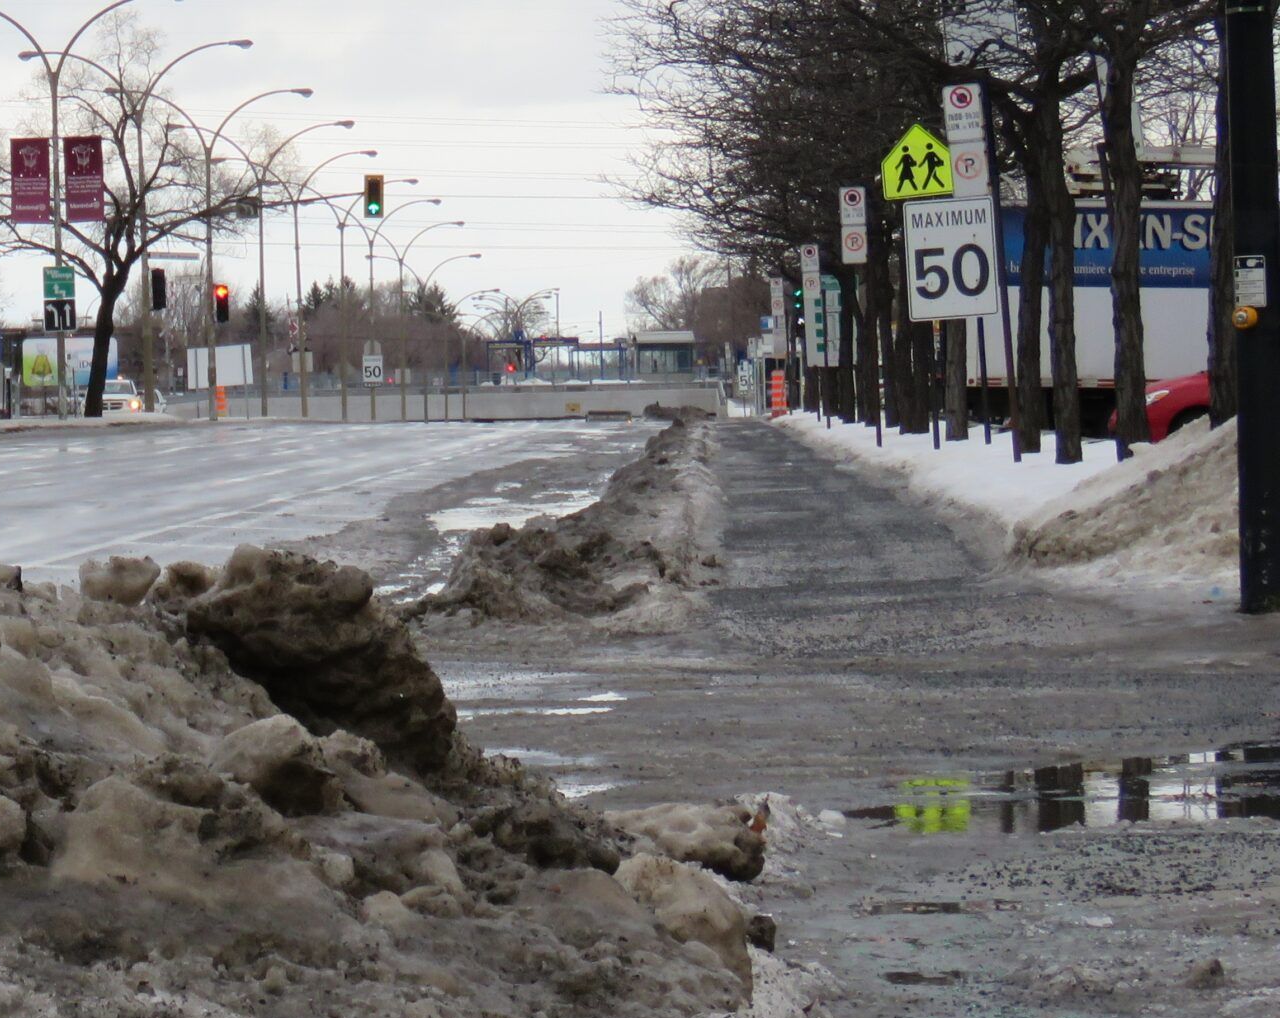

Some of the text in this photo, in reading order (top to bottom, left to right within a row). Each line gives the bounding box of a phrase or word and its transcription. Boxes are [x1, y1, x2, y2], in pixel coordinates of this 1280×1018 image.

[911, 208, 987, 229] MAXIMUM
[914, 243, 990, 300] 50
[1074, 263, 1106, 275] umière
[1149, 263, 1196, 276] entreprise
[365, 366, 381, 378] 50
